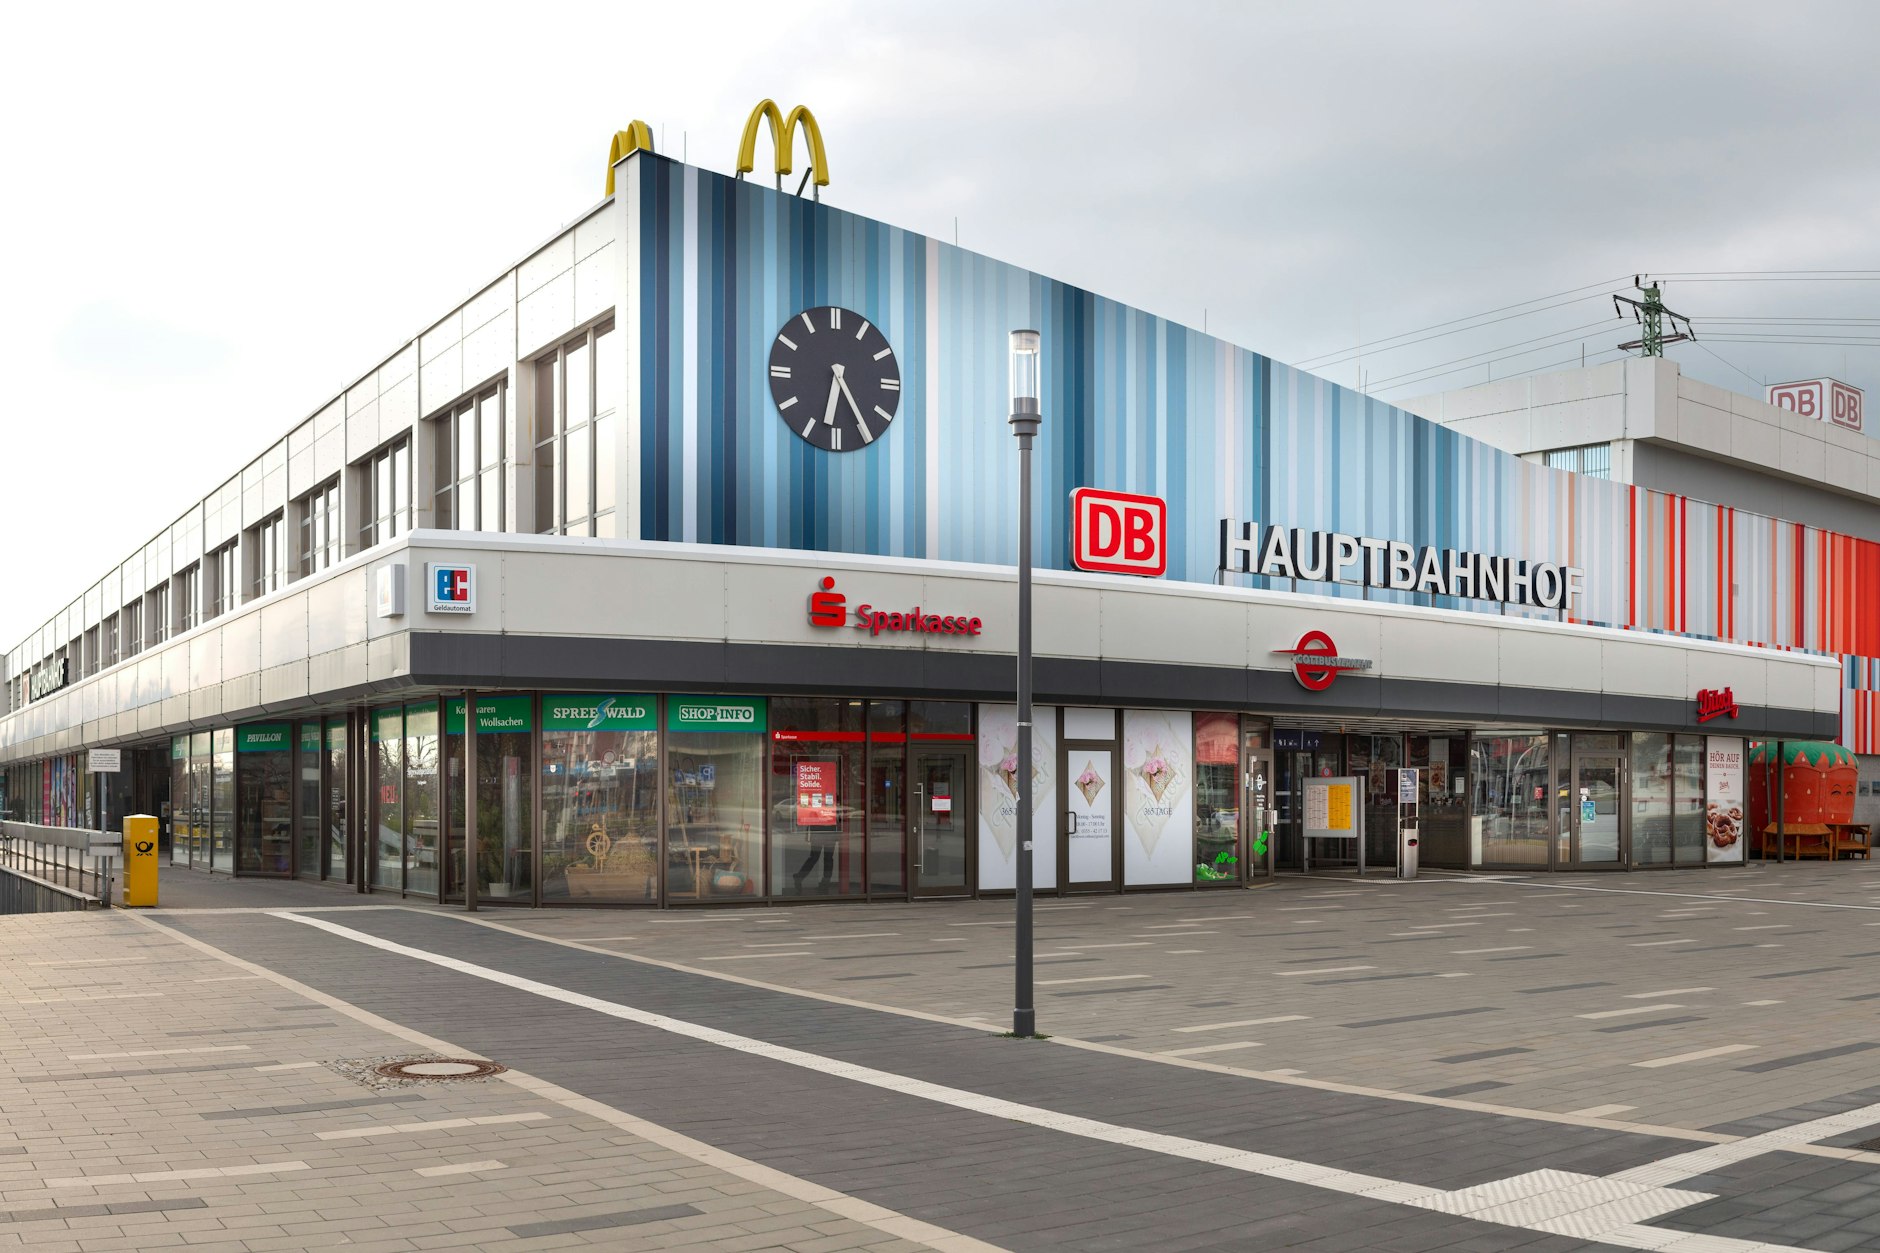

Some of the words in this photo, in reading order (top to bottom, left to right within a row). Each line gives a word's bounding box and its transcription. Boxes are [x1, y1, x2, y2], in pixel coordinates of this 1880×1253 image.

[1777, 389, 1816, 417] DB
[1835, 389, 1859, 423] DB
[1087, 503, 1156, 562] DB
[1220, 518, 1585, 610] HAUPTBAHNHOF
[433, 604, 472, 612] Geldautomat
[856, 603, 983, 637] Sparkasse
[681, 709, 716, 720] SHOP
[719, 710, 752, 720] INFO
[480, 717, 523, 727] Wollsachen
[246, 733, 282, 742] PAVILLON
[1709, 750, 1725, 762] HÖR
[1726, 753, 1740, 763] AUF
[800, 765, 822, 773] Sicher.
[800, 773, 822, 781] Stabil.
[800, 780, 822, 788] Solide.
[1001, 807, 1012, 816] 365
[1143, 807, 1154, 816] 365
[1155, 807, 1173, 816] TAGE
